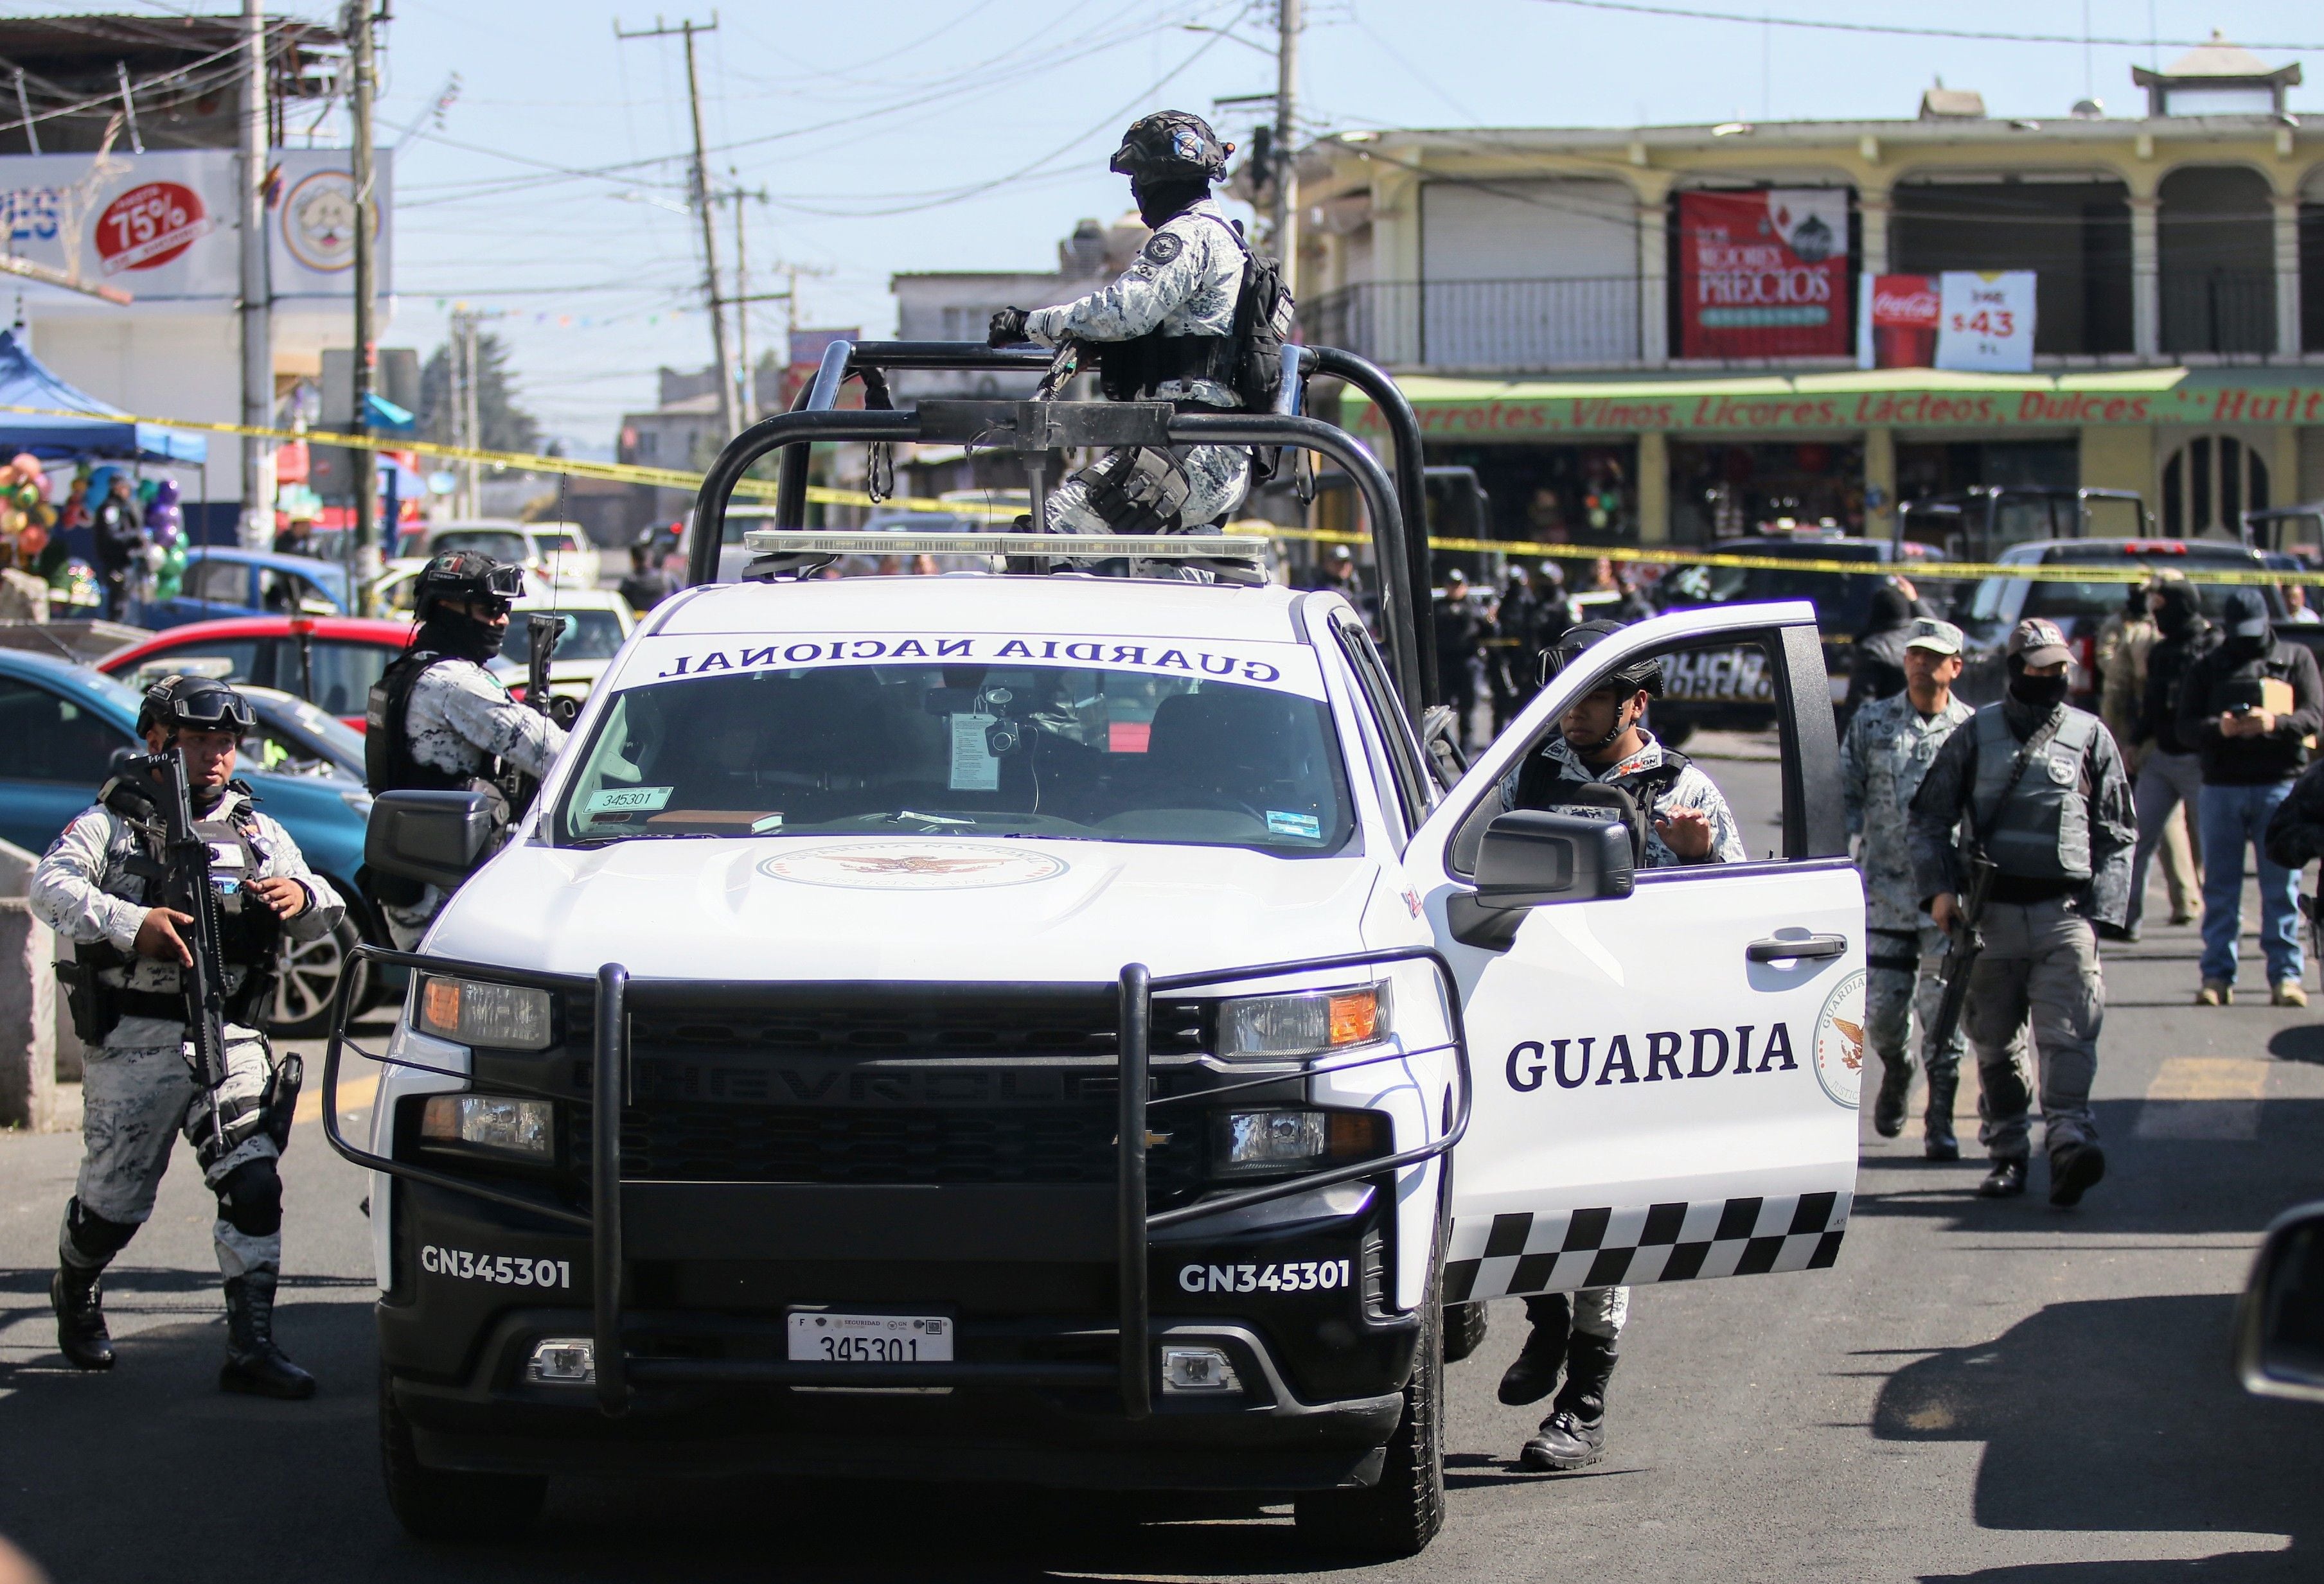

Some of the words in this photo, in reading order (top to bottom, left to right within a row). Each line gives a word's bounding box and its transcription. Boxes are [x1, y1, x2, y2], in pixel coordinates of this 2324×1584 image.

[109, 191, 188, 249] 75%
[1698, 267, 1831, 303] PRECIOS
[1952, 310, 2014, 339] $43
[1357, 398, 1561, 432] Arrotes,
[602, 793, 651, 807] 345301
[785, 843, 910, 861] GUARDIA
[924, 843, 1049, 864] NACIONAL
[1822, 977, 1866, 1030] GUARDIA
[1505, 1022, 1798, 1093] GUARDIA
[421, 1245, 570, 1289] GN345301
[1179, 1259, 1350, 1292] GN345301
[799, 1318, 805, 1326] F
[820, 1336, 917, 1361] 345301
